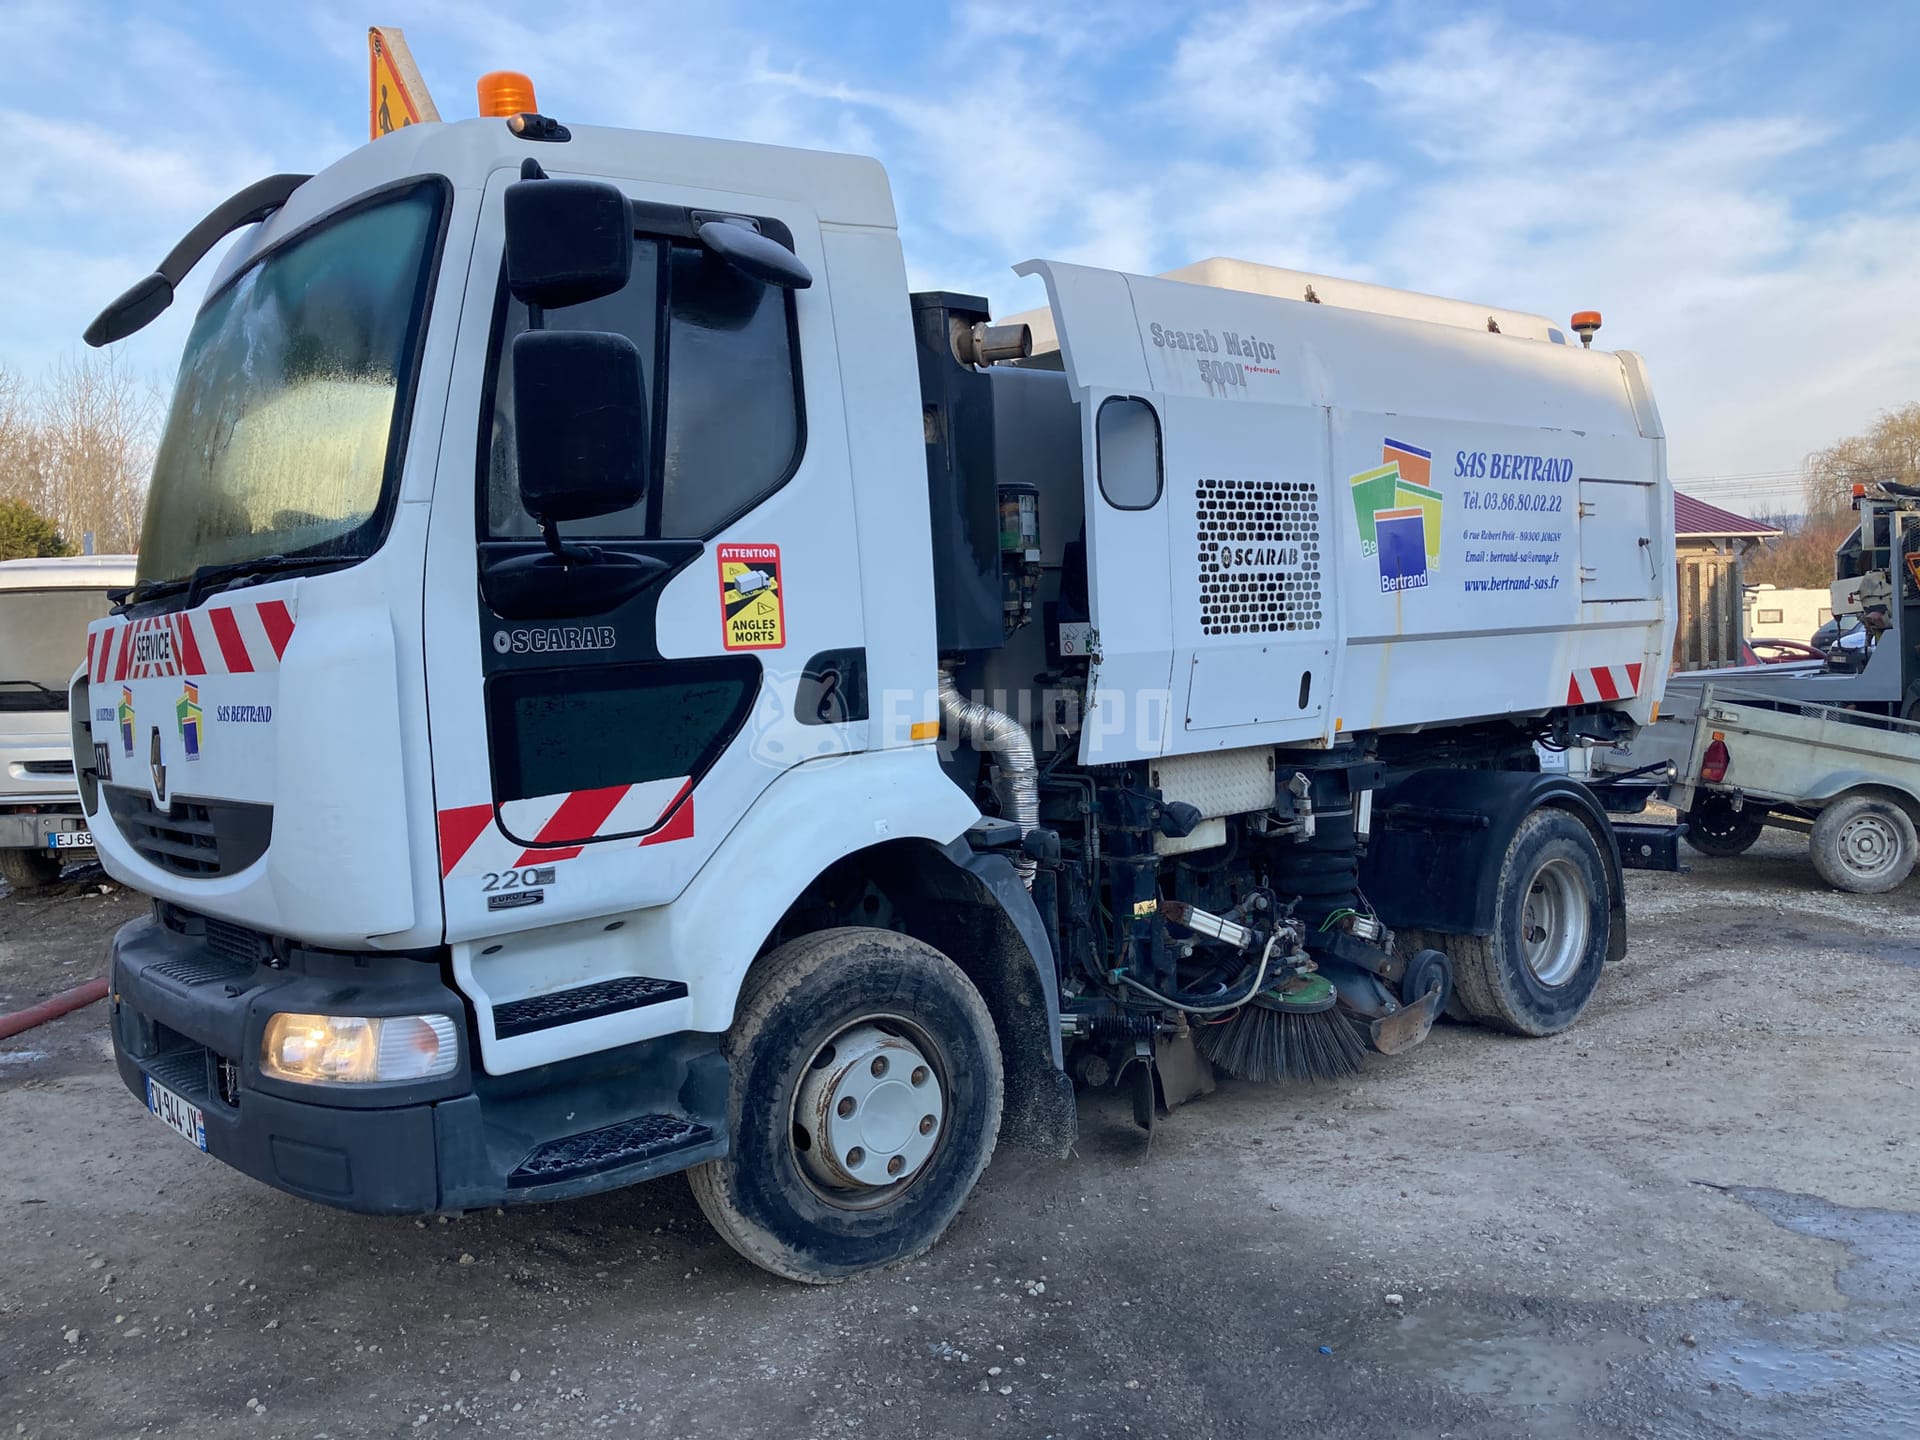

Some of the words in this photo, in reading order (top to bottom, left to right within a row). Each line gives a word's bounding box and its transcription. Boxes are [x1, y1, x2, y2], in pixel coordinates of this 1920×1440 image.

[1150, 322, 1219, 353] Scarab
[1223, 331, 1277, 364] Major
[1454, 450, 1487, 478] SAS
[1490, 453, 1573, 483] BERTRAND
[1463, 491, 1481, 510] Tél.
[1484, 492, 1562, 513] 03.86.80.02.22
[1481, 530, 1501, 540] Robert
[1502, 531, 1515, 541] Petit
[1520, 531, 1540, 542] 89300
[721, 548, 777, 558] ATTENTION
[1233, 548, 1298, 566] SCARAB
[1465, 551, 1485, 563] Email
[1381, 569, 1427, 592] Bertrand
[1464, 575, 1560, 592] www.bertrand-sas.fr
[732, 619, 776, 631] ANGLES
[511, 626, 616, 653] SCARAB
[735, 631, 775, 643] MORTS
[137, 631, 169, 662] SERVICE
[217, 705, 230, 722] SAS
[231, 705, 272, 723] BERTRAND
[481, 868, 538, 892] 220
